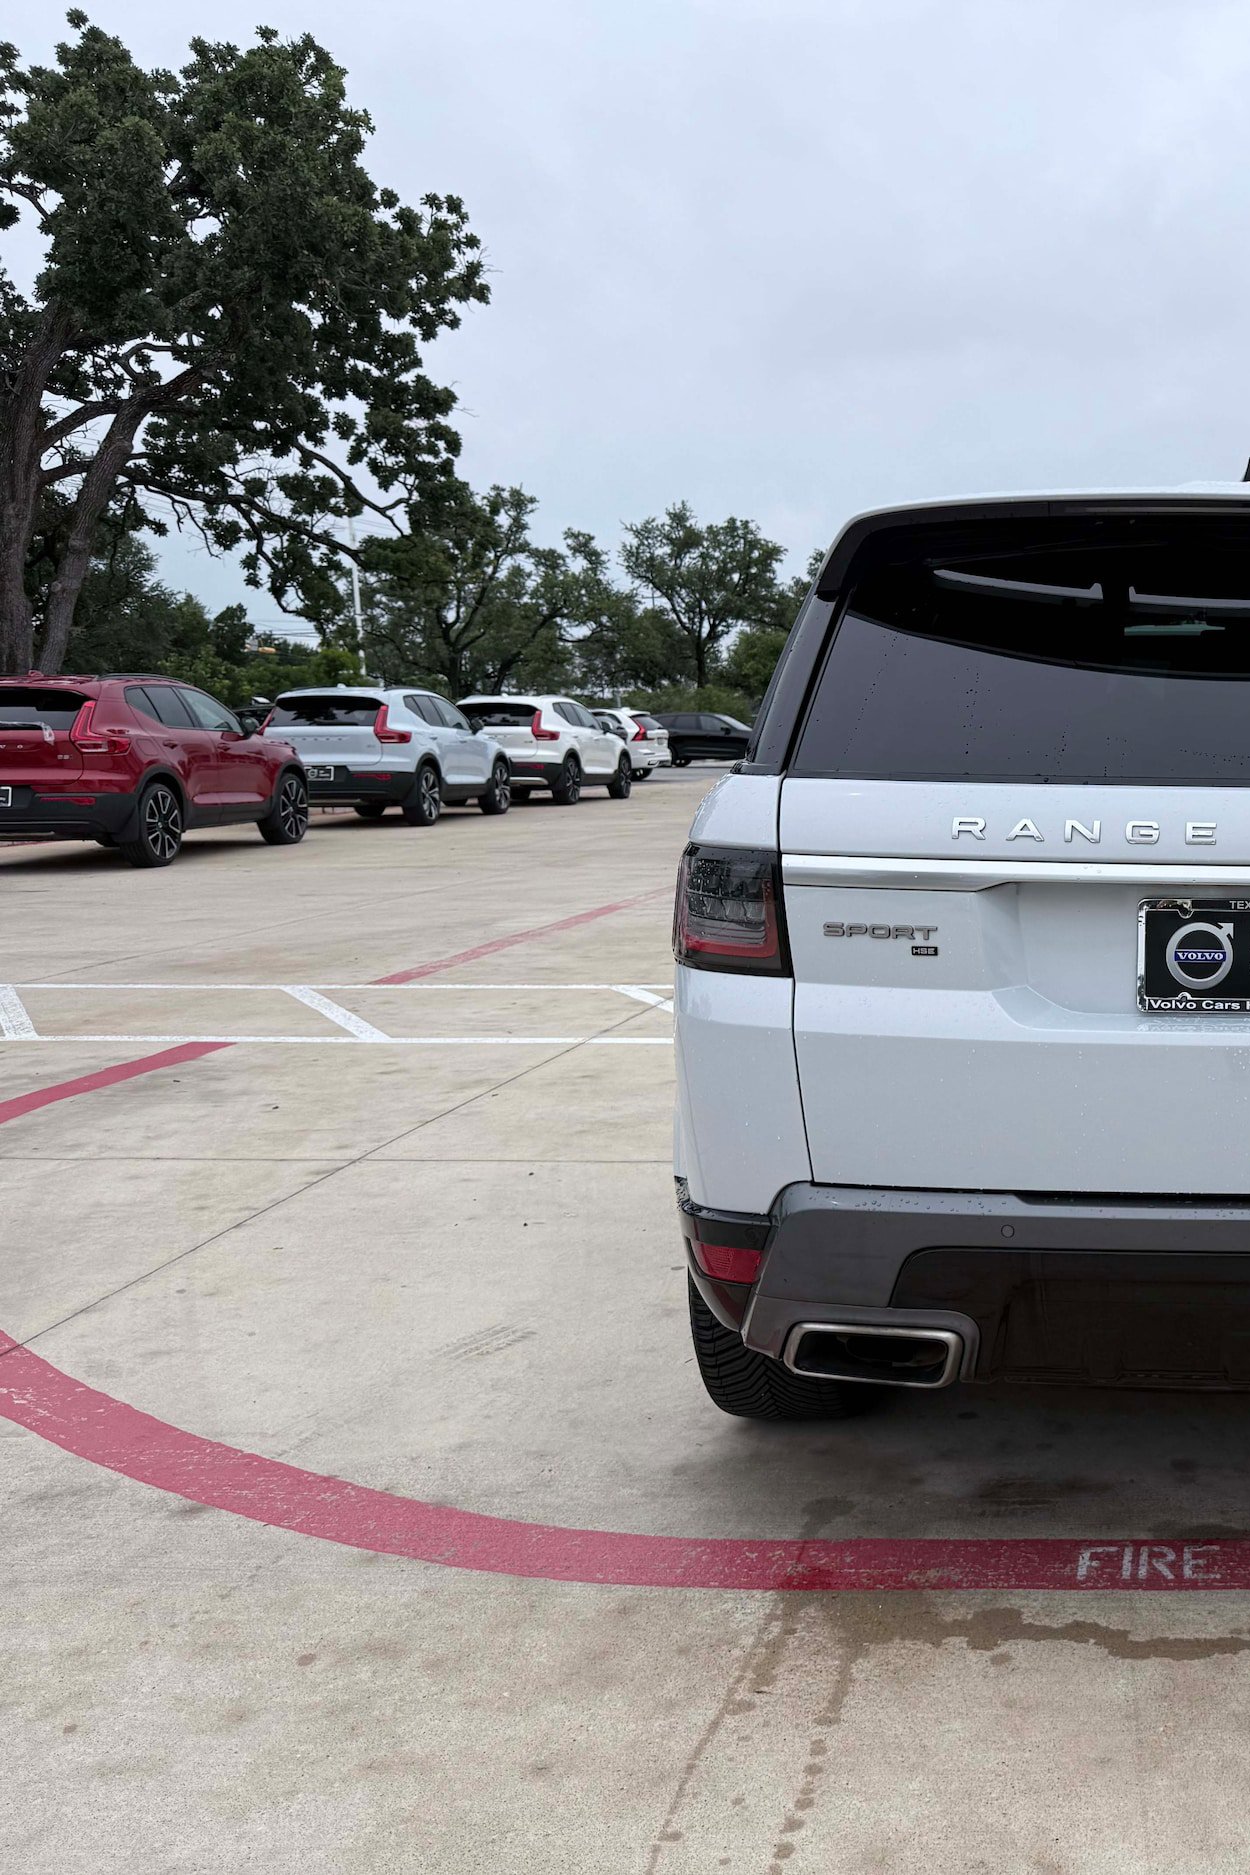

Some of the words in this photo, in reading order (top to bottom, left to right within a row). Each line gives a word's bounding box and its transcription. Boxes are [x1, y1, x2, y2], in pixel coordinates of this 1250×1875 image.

[952, 817, 1217, 845] RANGE
[823, 921, 938, 940] SPORT
[913, 947, 936, 955] HSE
[1176, 951, 1224, 961] VOLVO
[1150, 1000, 1197, 1010] Volvo
[1201, 1000, 1241, 1010] Cars
[1077, 1545, 1222, 1580] FIRE
